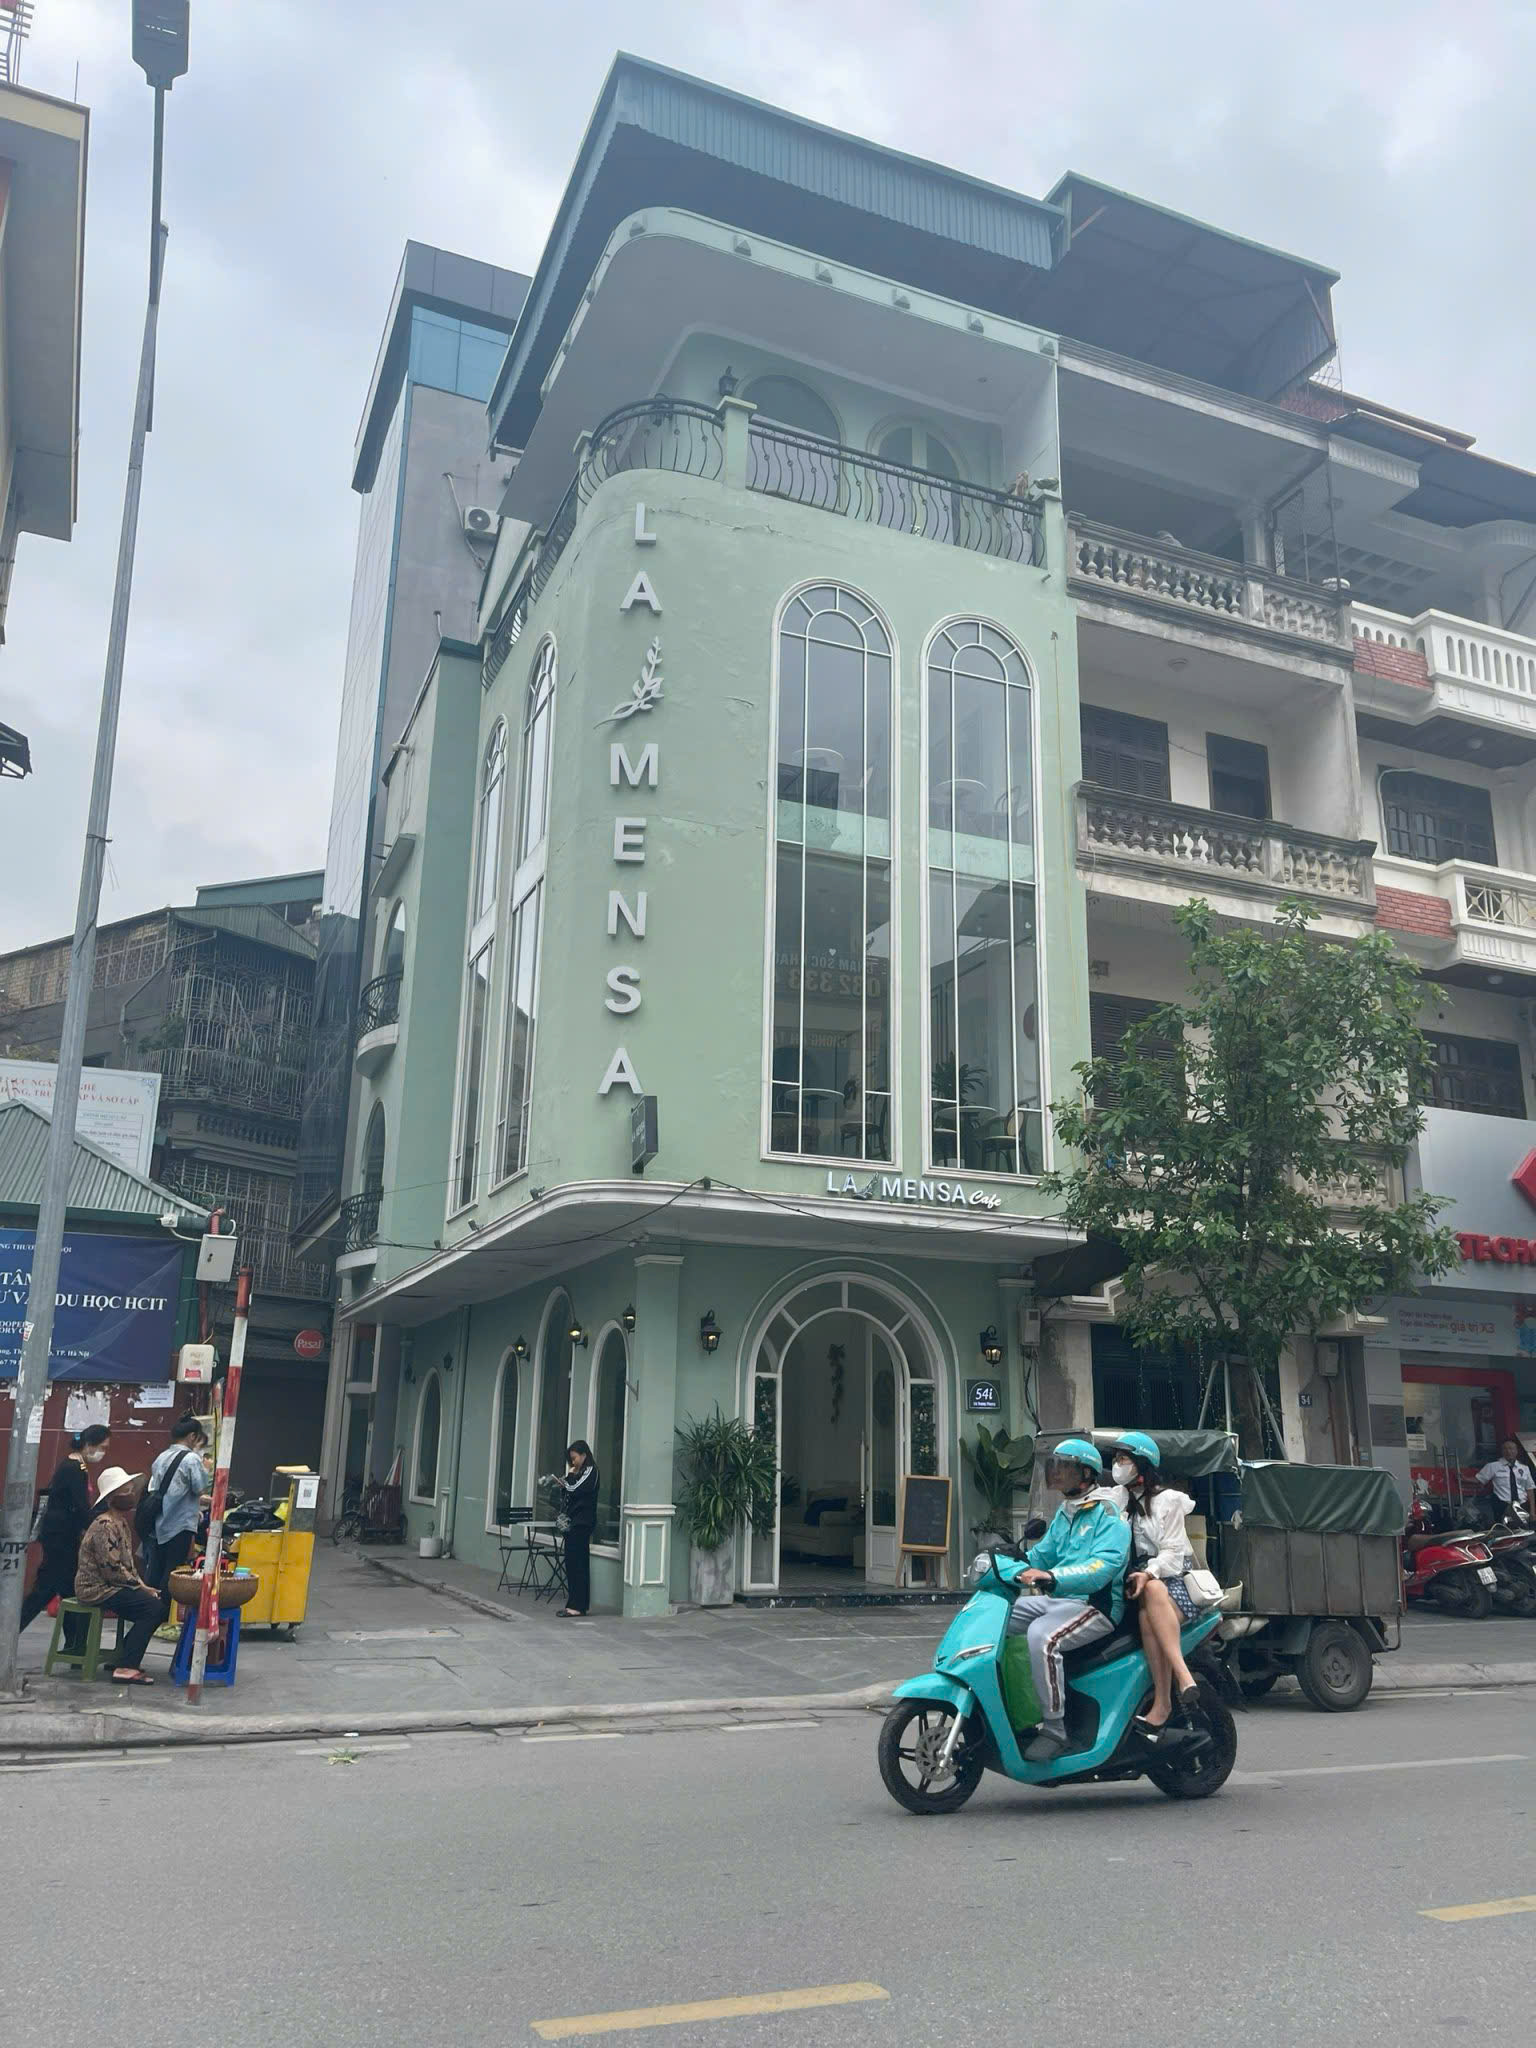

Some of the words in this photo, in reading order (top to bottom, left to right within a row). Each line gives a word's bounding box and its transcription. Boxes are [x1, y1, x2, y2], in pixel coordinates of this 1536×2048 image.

[619, 501, 663, 614] LA
[596, 742, 661, 1096] MENSA
[826, 1171, 858, 1194] LA
[881, 1176, 967, 1205] MENSA
[969, 1190, 1002, 1209] Cafe
[55, 1293, 80, 1308] DU
[82, 1295, 122, 1312] HỌC
[124, 1296, 168, 1312] HCIT
[975, 1387, 993, 1401] 54i
[1300, 1395, 1311, 1405] 54
[3, 1558, 19, 1571] 21
